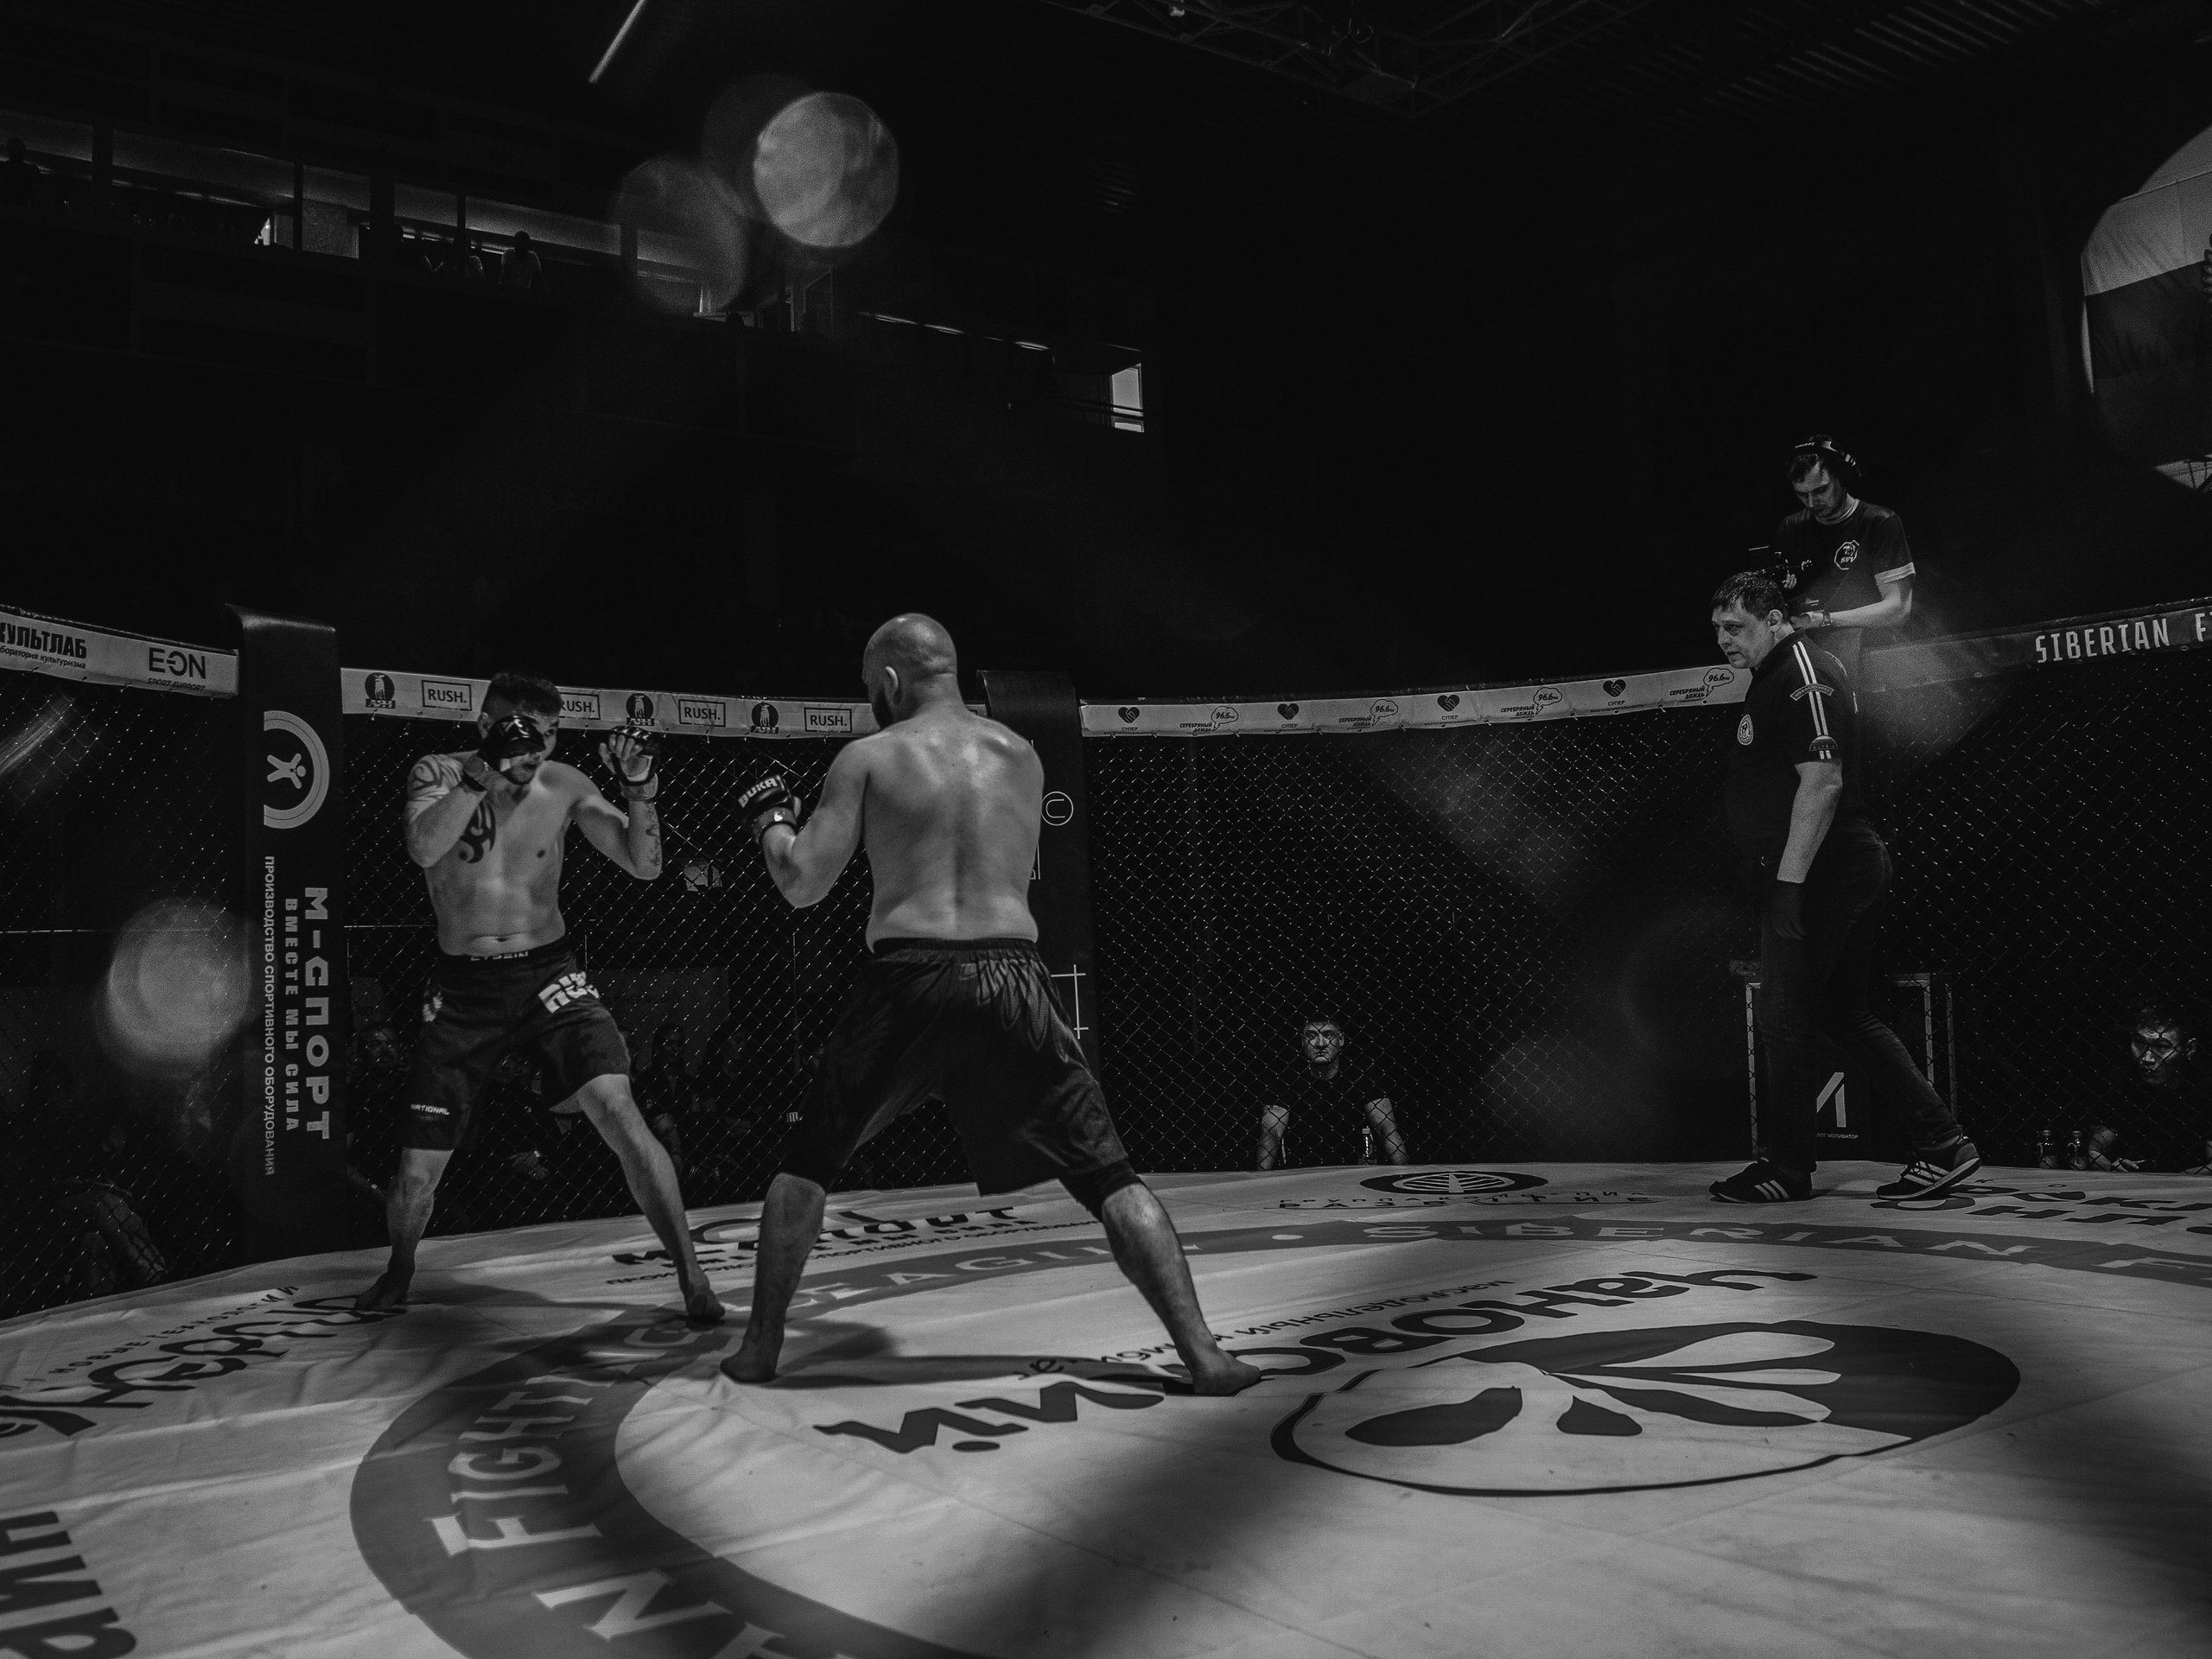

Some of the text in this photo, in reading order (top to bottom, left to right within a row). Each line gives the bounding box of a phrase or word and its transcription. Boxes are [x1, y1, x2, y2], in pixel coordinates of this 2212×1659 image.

[2035, 618, 2171, 664] SIBERIAN
[40, 655, 86, 670] культуризма
[428, 689, 467, 703] RUSH.
[1669, 685, 1706, 696] СЕРЕБРЯНЫЙ
[683, 707, 721, 721] RUSH.
[810, 715, 848, 727] RUSH.
[1500, 704, 1535, 714] СЕРЕБРЯНЫЙ
[264, 855, 276, 1176] ПРОИЗВОДСТВО СПОРТИВНОГО ОБОРУДОВАНИЯ
[284, 898, 300, 1131] ВМЕСТЕ МЫ СИЛА
[304, 887, 330, 1140] М-СПОРТ
[1363, 1221, 2040, 1257] SIBERIAN
[812, 1268, 1818, 1454] Чановсий
